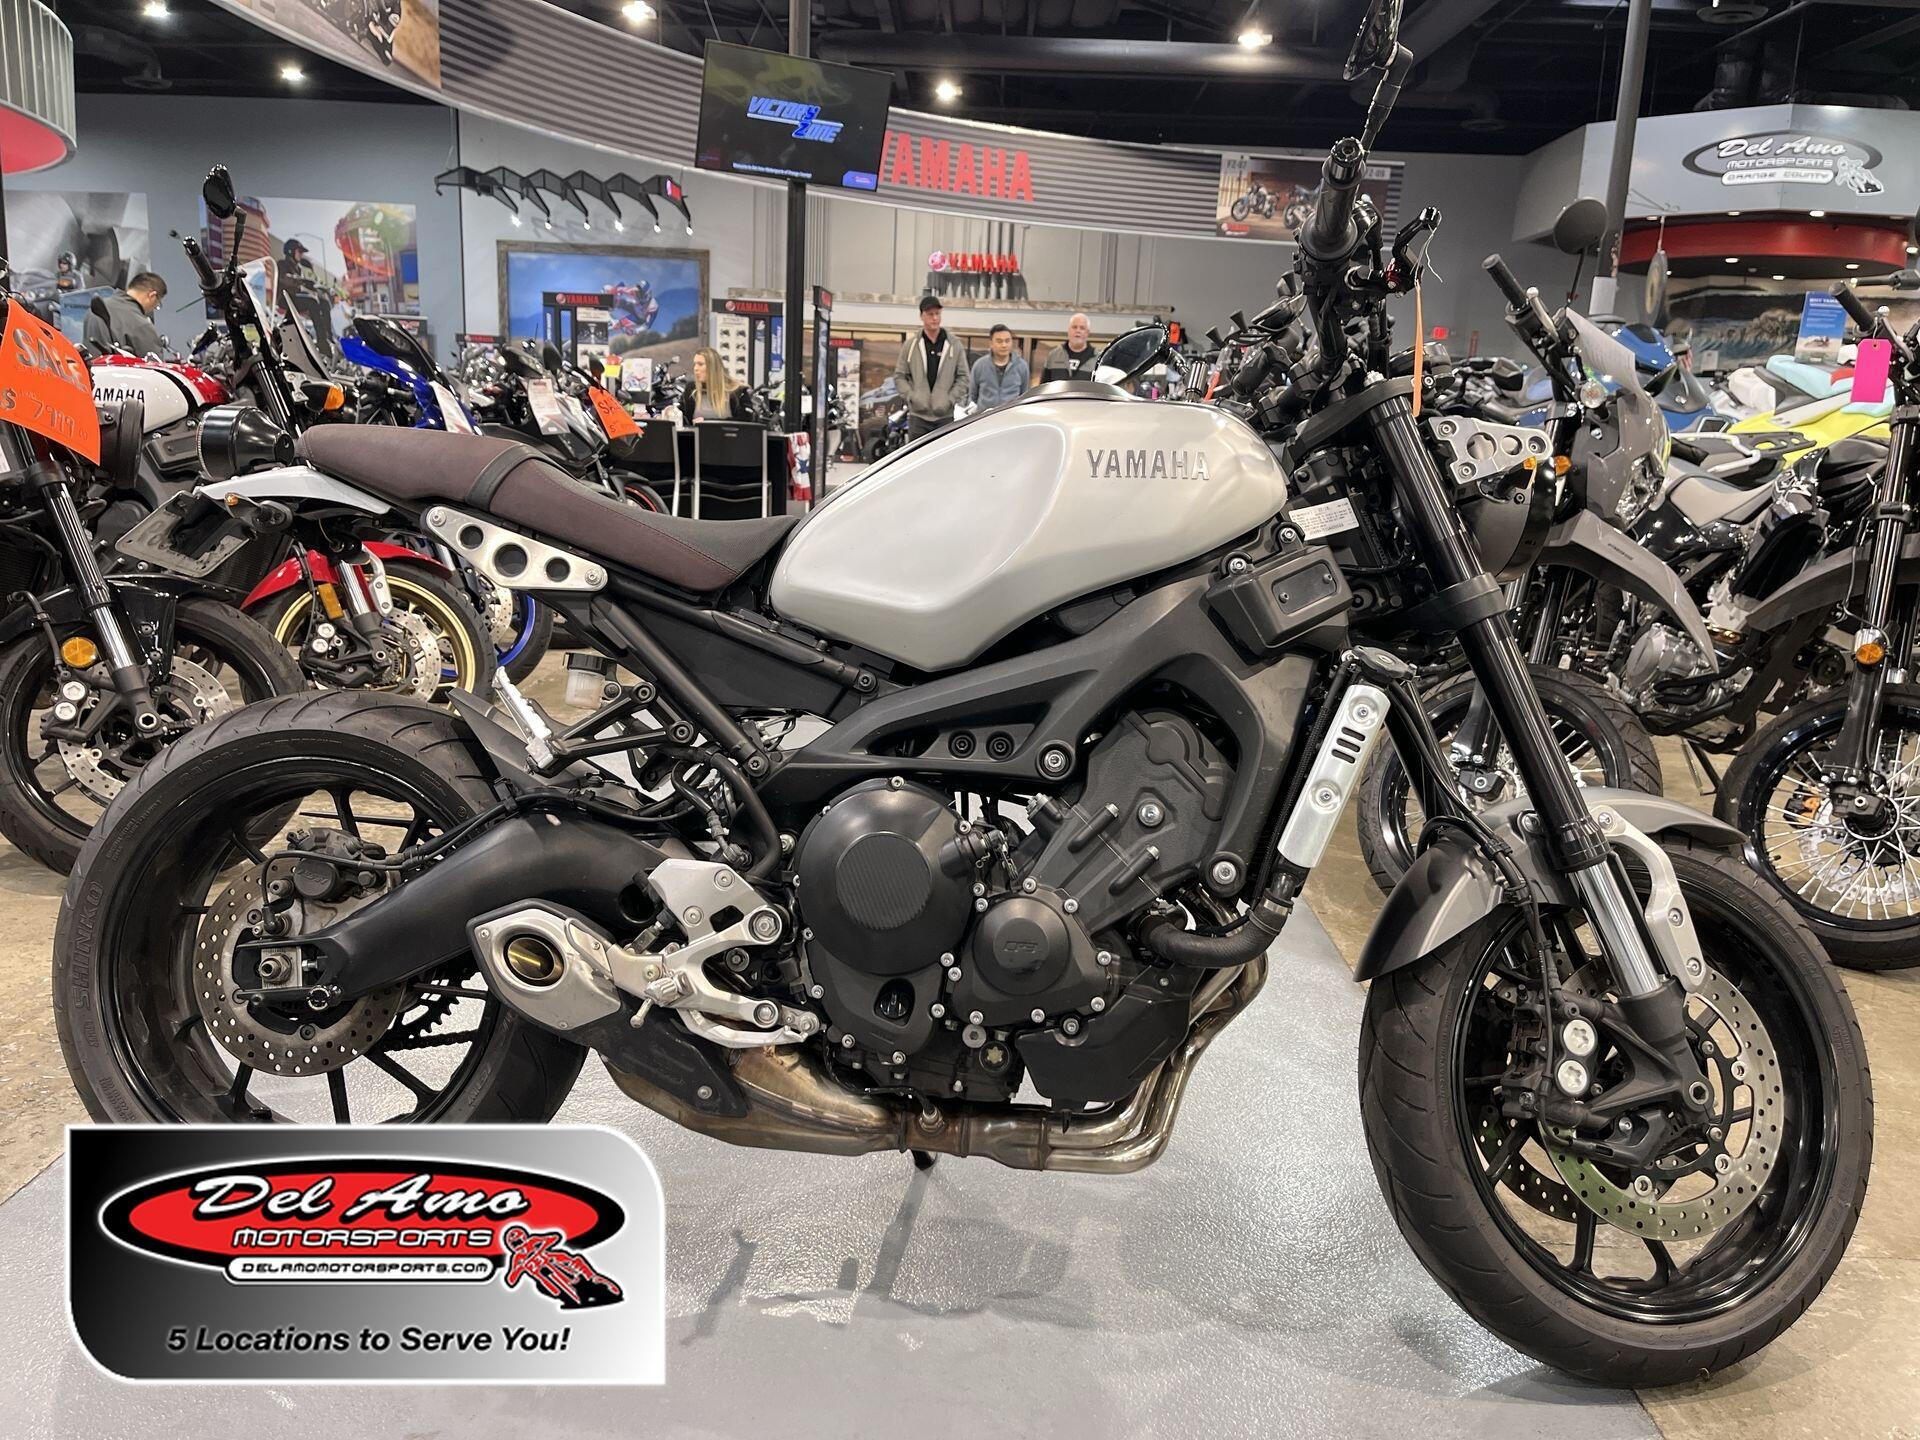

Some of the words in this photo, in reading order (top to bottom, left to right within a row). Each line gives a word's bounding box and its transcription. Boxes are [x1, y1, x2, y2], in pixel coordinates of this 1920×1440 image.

[748, 95, 821, 121] VICTORY
[792, 119, 843, 143] ZONE
[1717, 137, 1774, 159] Del
[1774, 135, 1847, 156] Amo
[1726, 157, 1834, 170] MOTORSPORTS
[1727, 171, 1777, 181] ORANGE
[1783, 170, 1829, 180] COUNTY
[948, 252, 1019, 273] YAMAHA
[566, 294, 600, 305] YAMAHA
[735, 302, 770, 313] YAMAHA
[94, 387, 145, 403] AMAHA
[1086, 448, 1210, 481] YAMAHA
